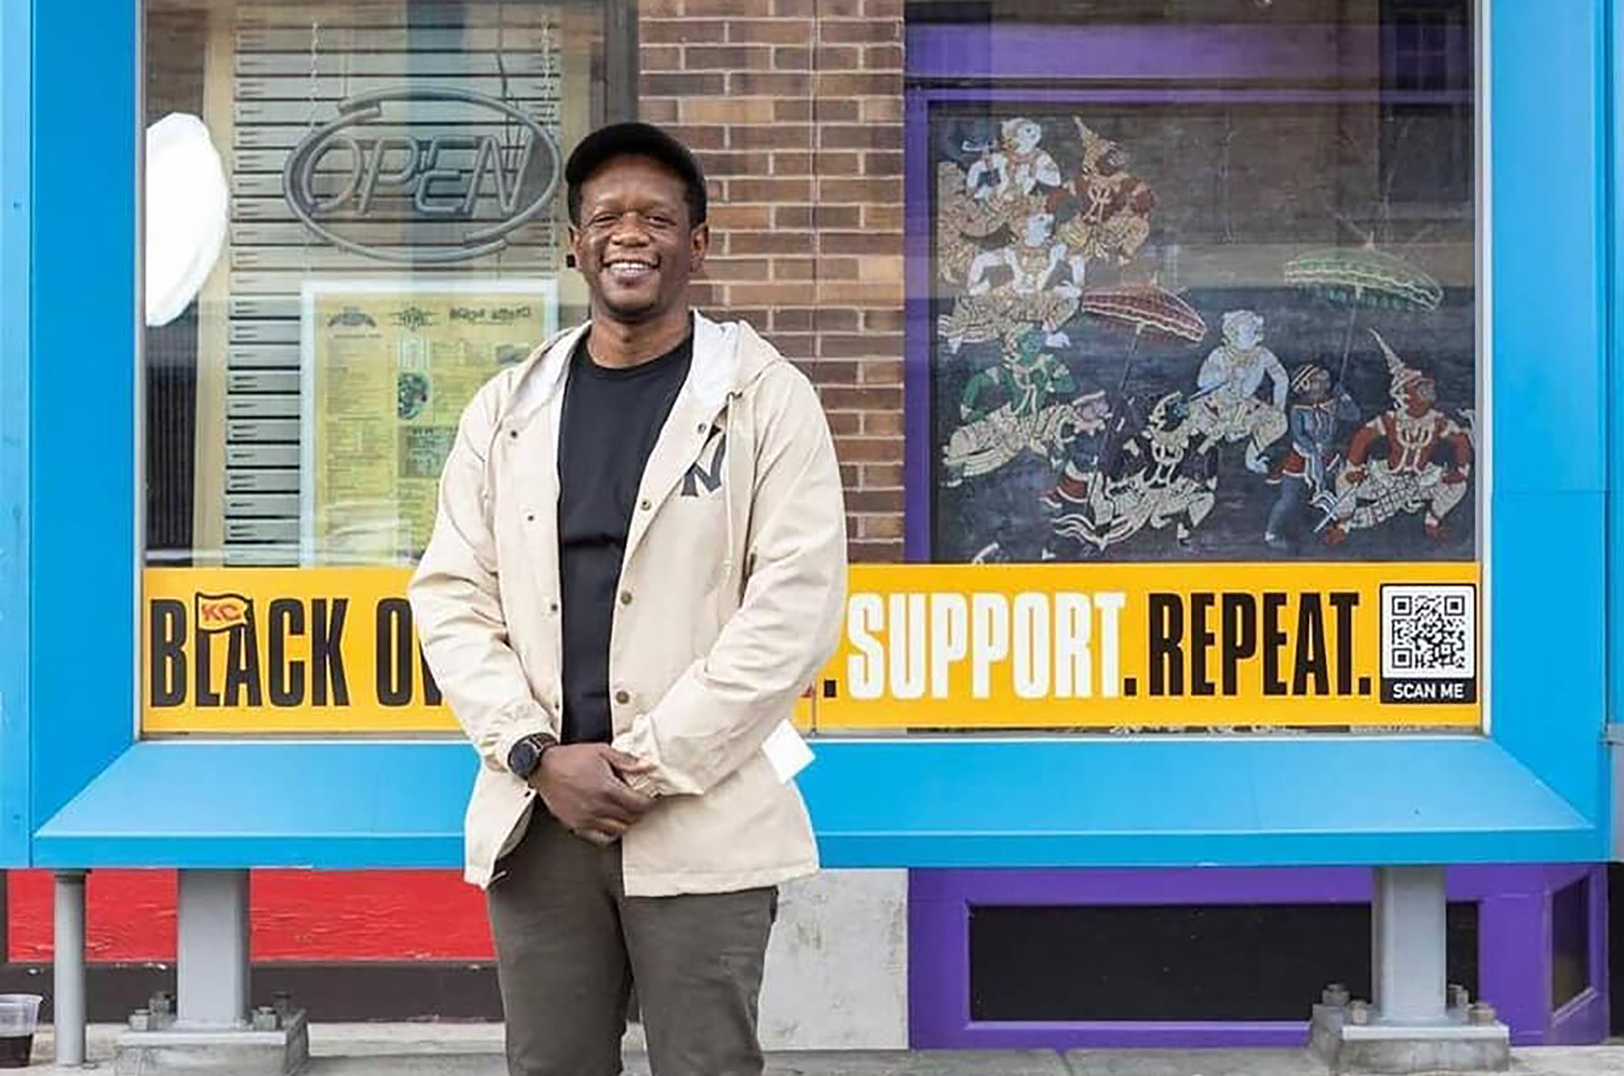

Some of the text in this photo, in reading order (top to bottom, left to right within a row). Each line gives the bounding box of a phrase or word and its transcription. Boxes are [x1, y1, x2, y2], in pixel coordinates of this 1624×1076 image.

[302, 134, 535, 216] OPEN
[200, 601, 243, 623] KC
[150, 597, 350, 707] BLACK
[1392, 683, 1465, 699] SCAN ME
